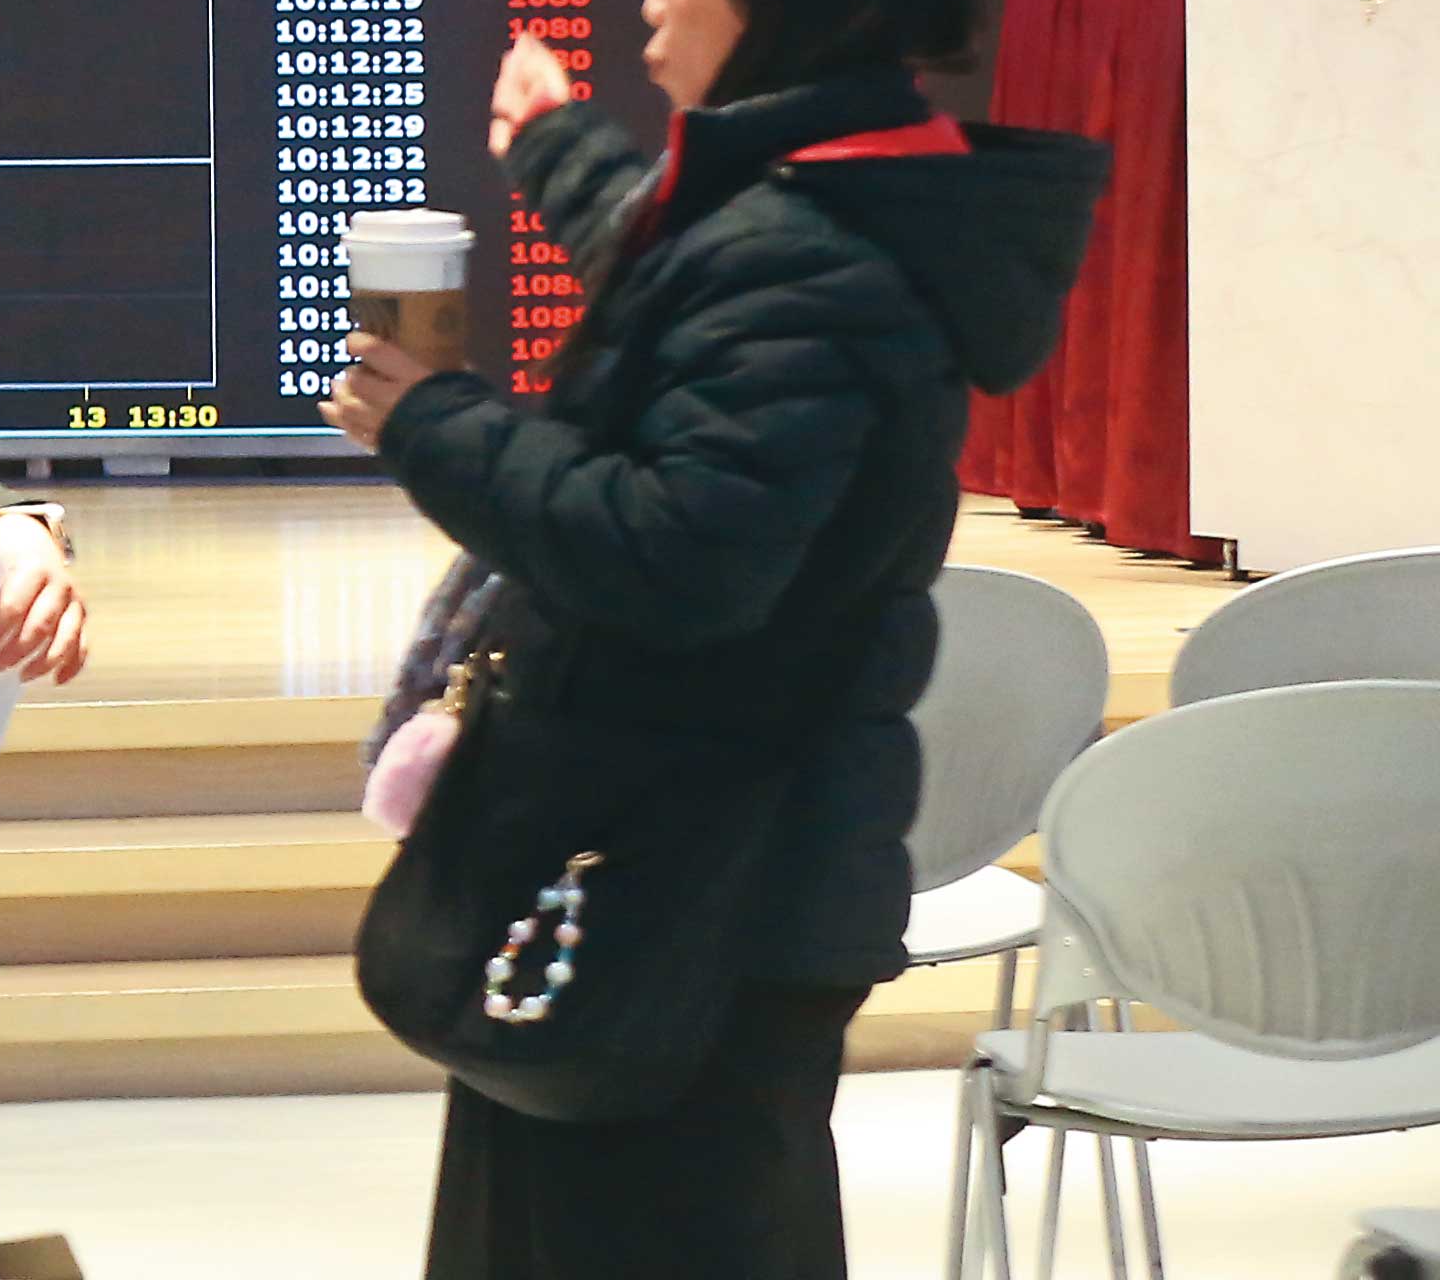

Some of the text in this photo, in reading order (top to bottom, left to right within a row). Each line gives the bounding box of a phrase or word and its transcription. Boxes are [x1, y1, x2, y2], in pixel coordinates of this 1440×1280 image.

[278, 83, 424, 106] 10:12:25
[70, 406, 217, 427] 13 13:30
